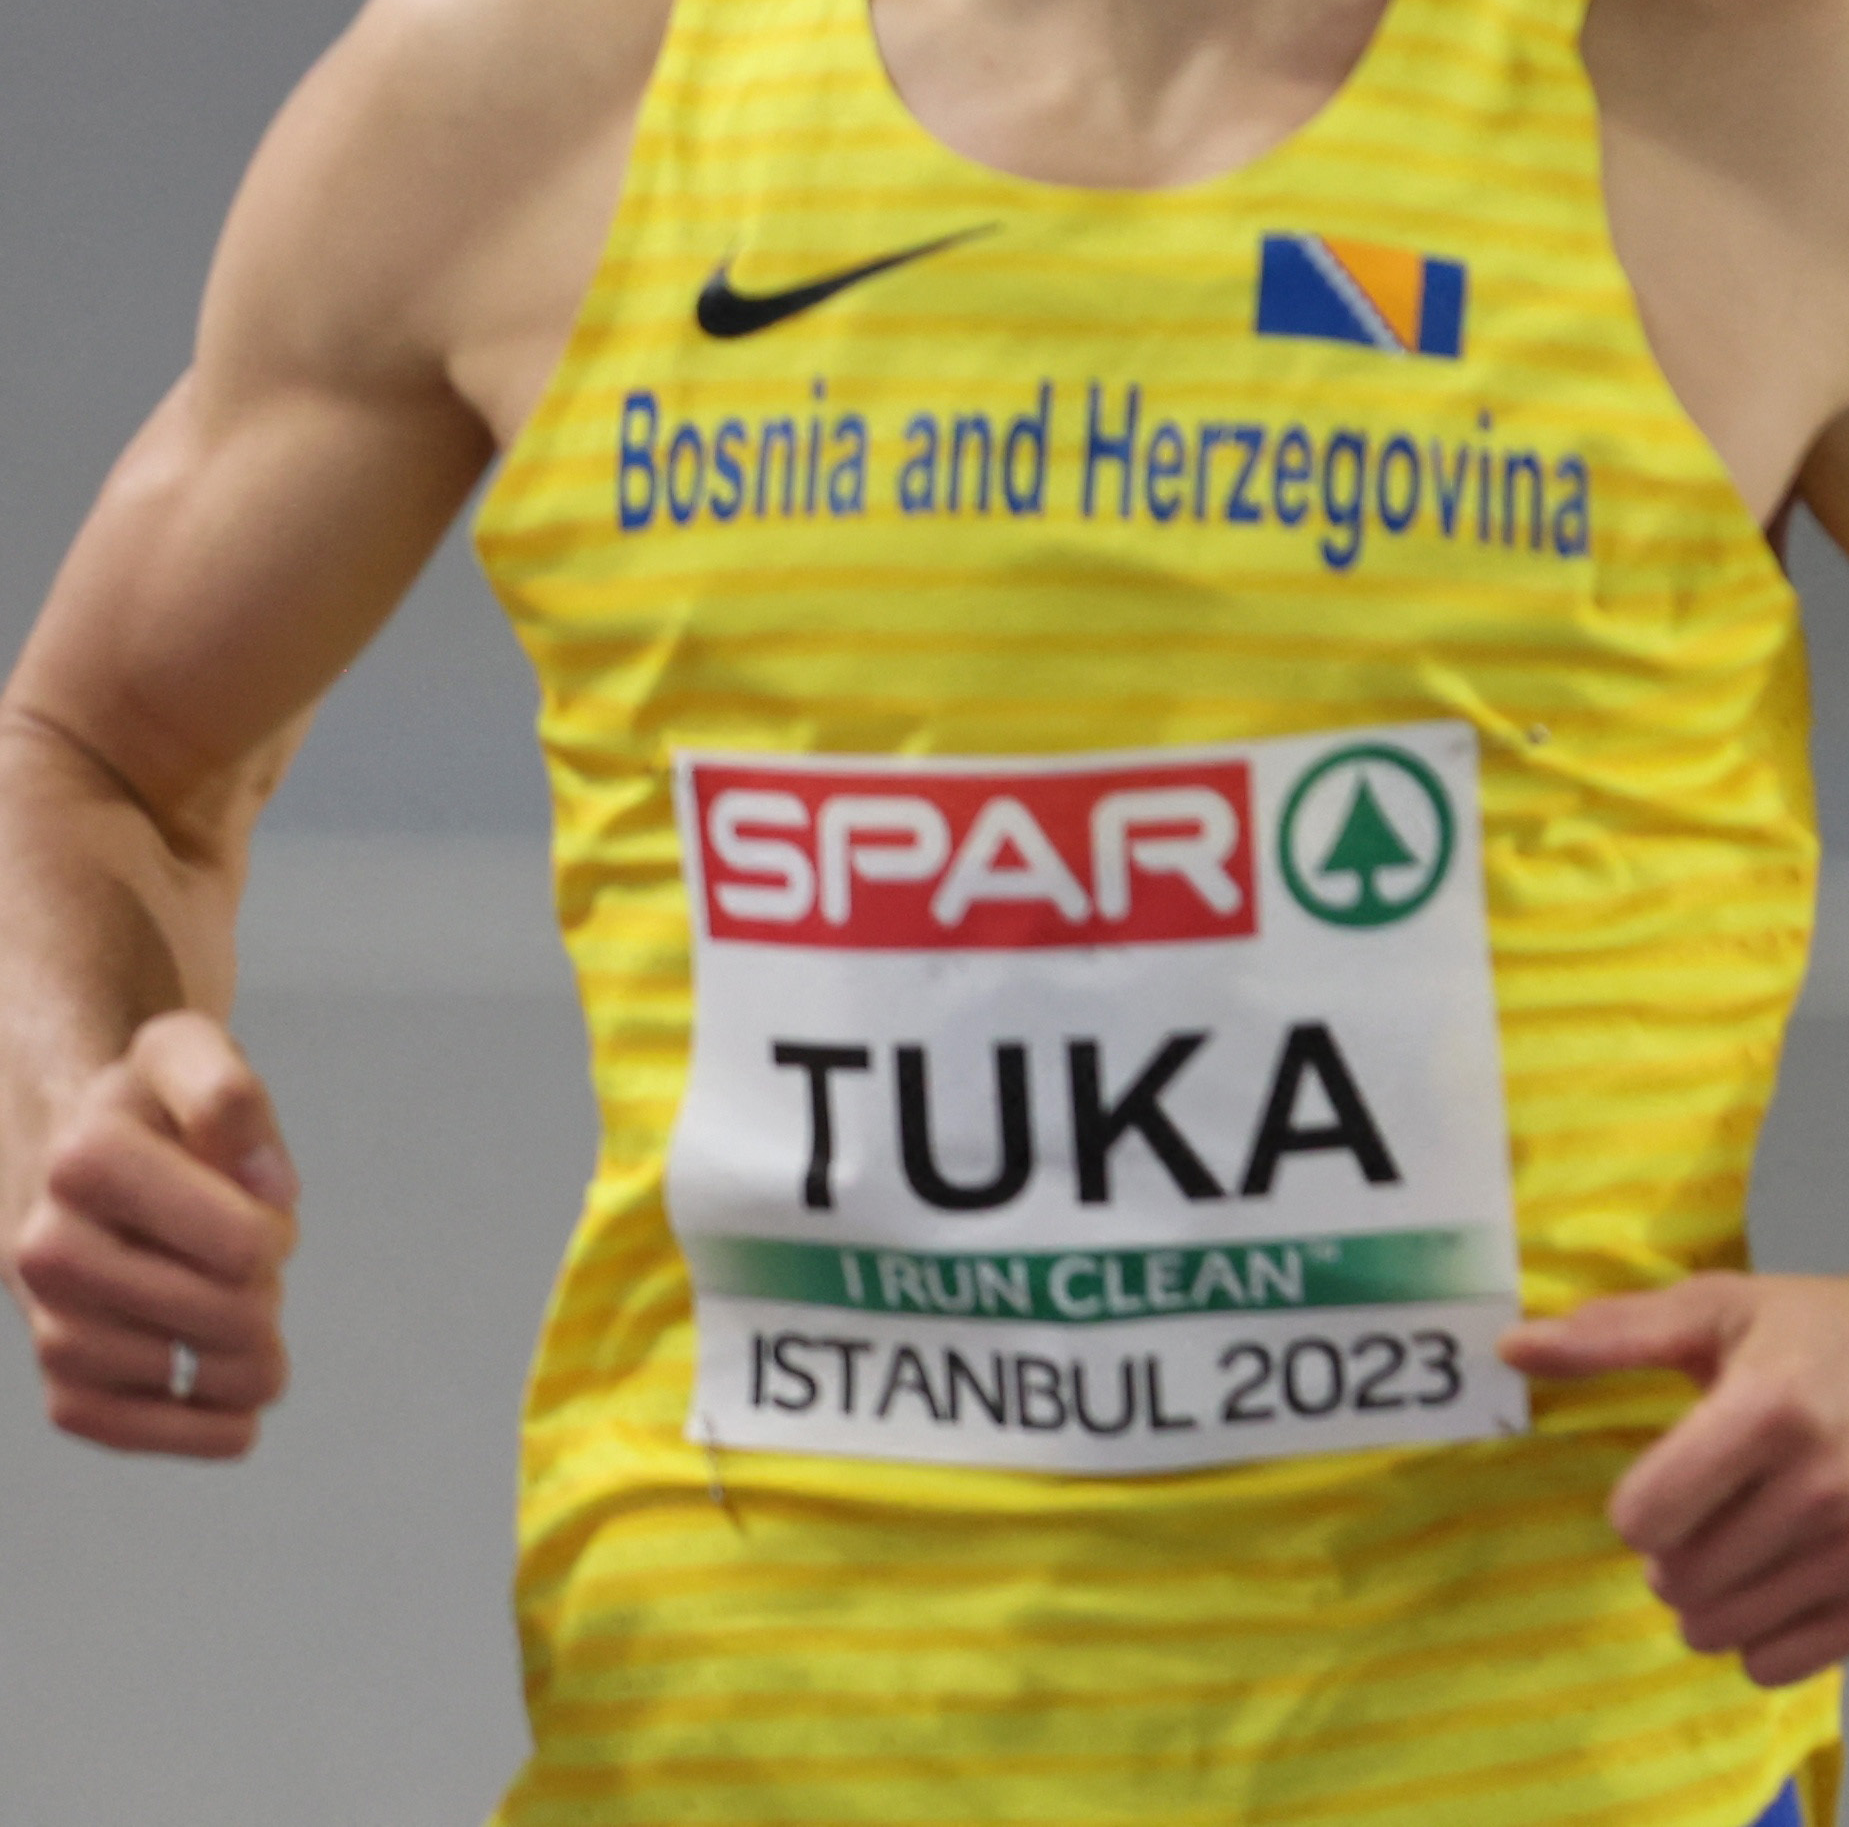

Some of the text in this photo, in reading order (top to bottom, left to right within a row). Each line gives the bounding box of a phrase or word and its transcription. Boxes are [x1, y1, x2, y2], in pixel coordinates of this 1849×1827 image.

[616, 377, 1590, 571] Bosnia and Herzegovina
[708, 784, 1243, 927] SPAR
[771, 1020, 1402, 1210] TUKA
[840, 1249, 865, 1304] I
[877, 1253, 1031, 1316] RUN
[750, 1330, 1464, 1435] ISTANBUL 2023
